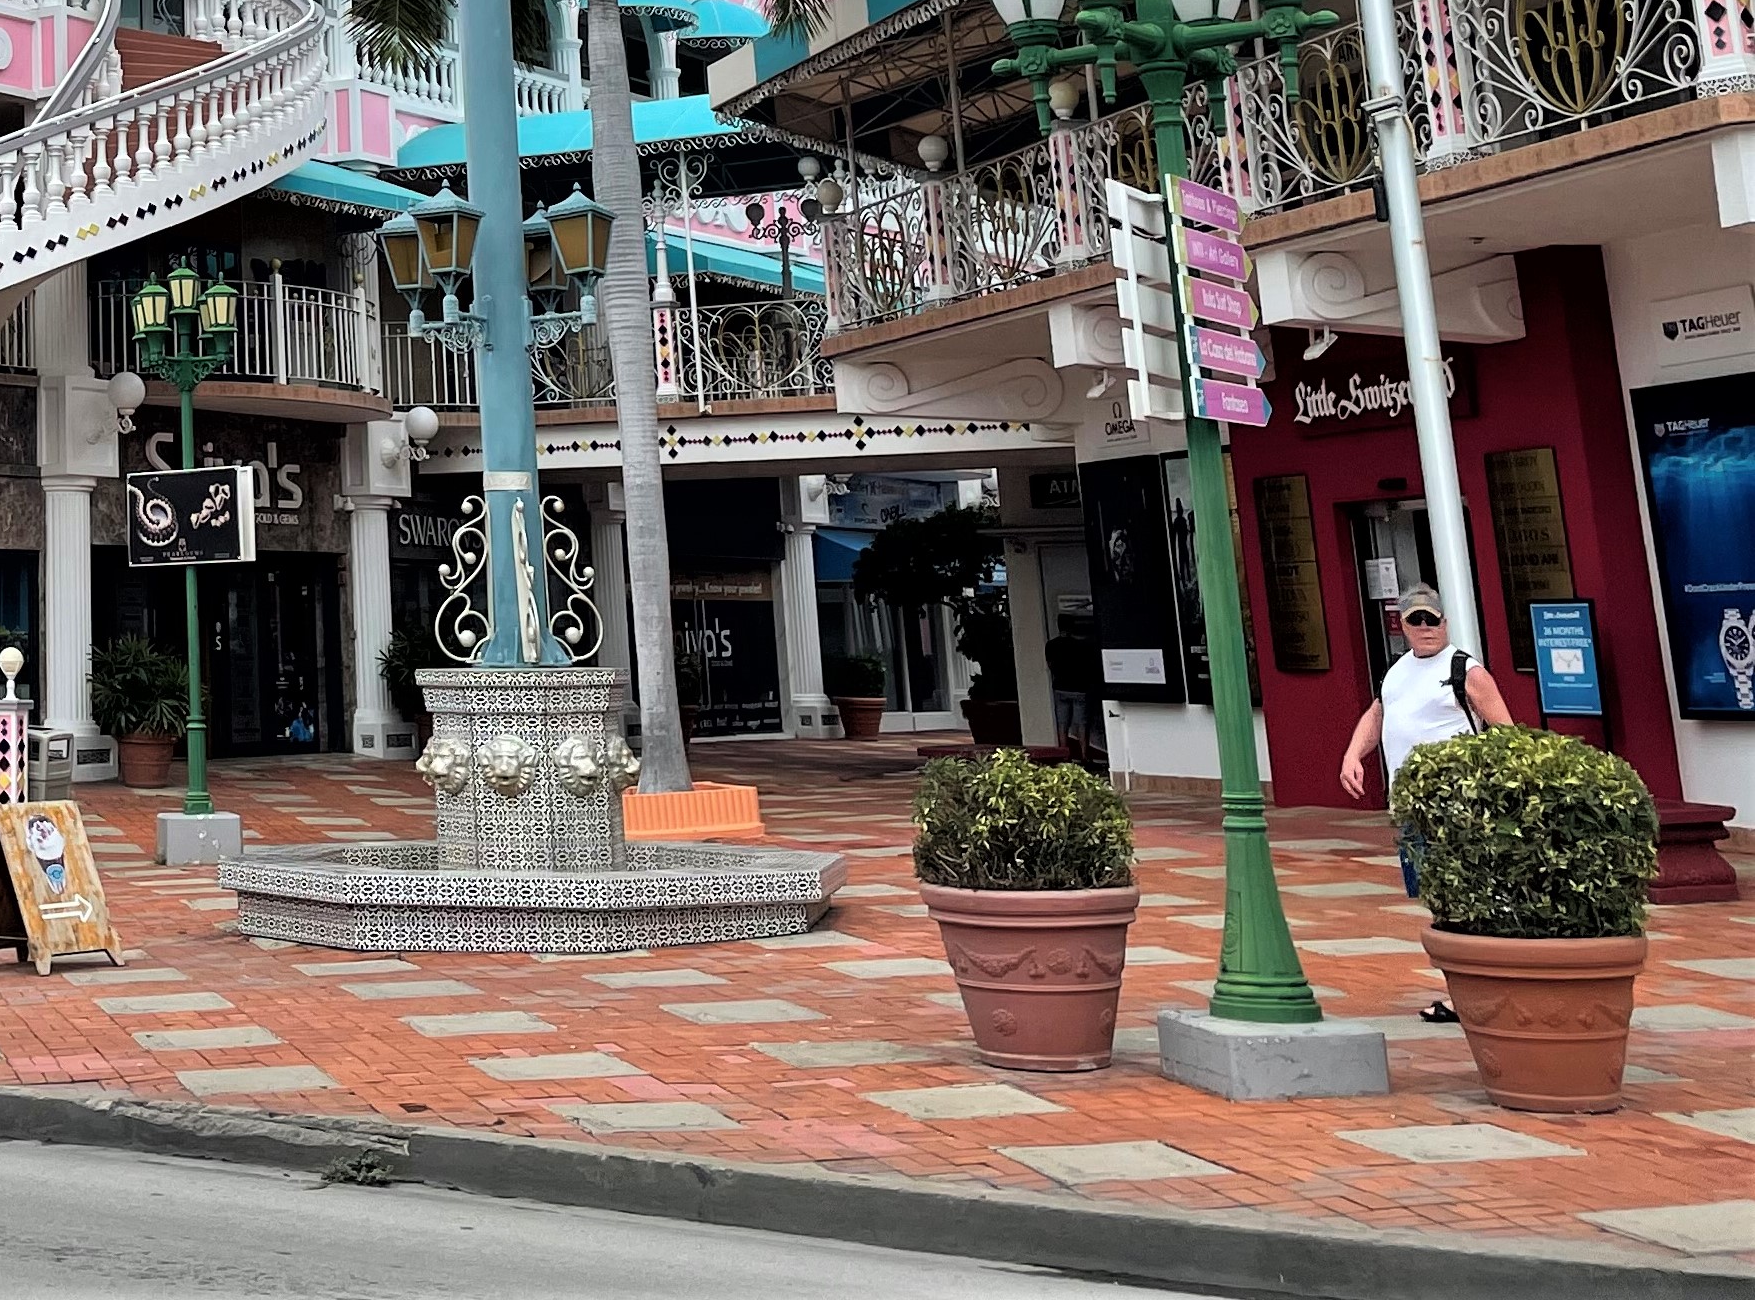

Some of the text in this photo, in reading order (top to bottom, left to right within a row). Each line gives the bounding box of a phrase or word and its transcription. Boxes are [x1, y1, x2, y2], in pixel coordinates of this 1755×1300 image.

[1294, 357, 1455, 424] Little Switzed
[1105, 420, 1135, 436] OMEGA
